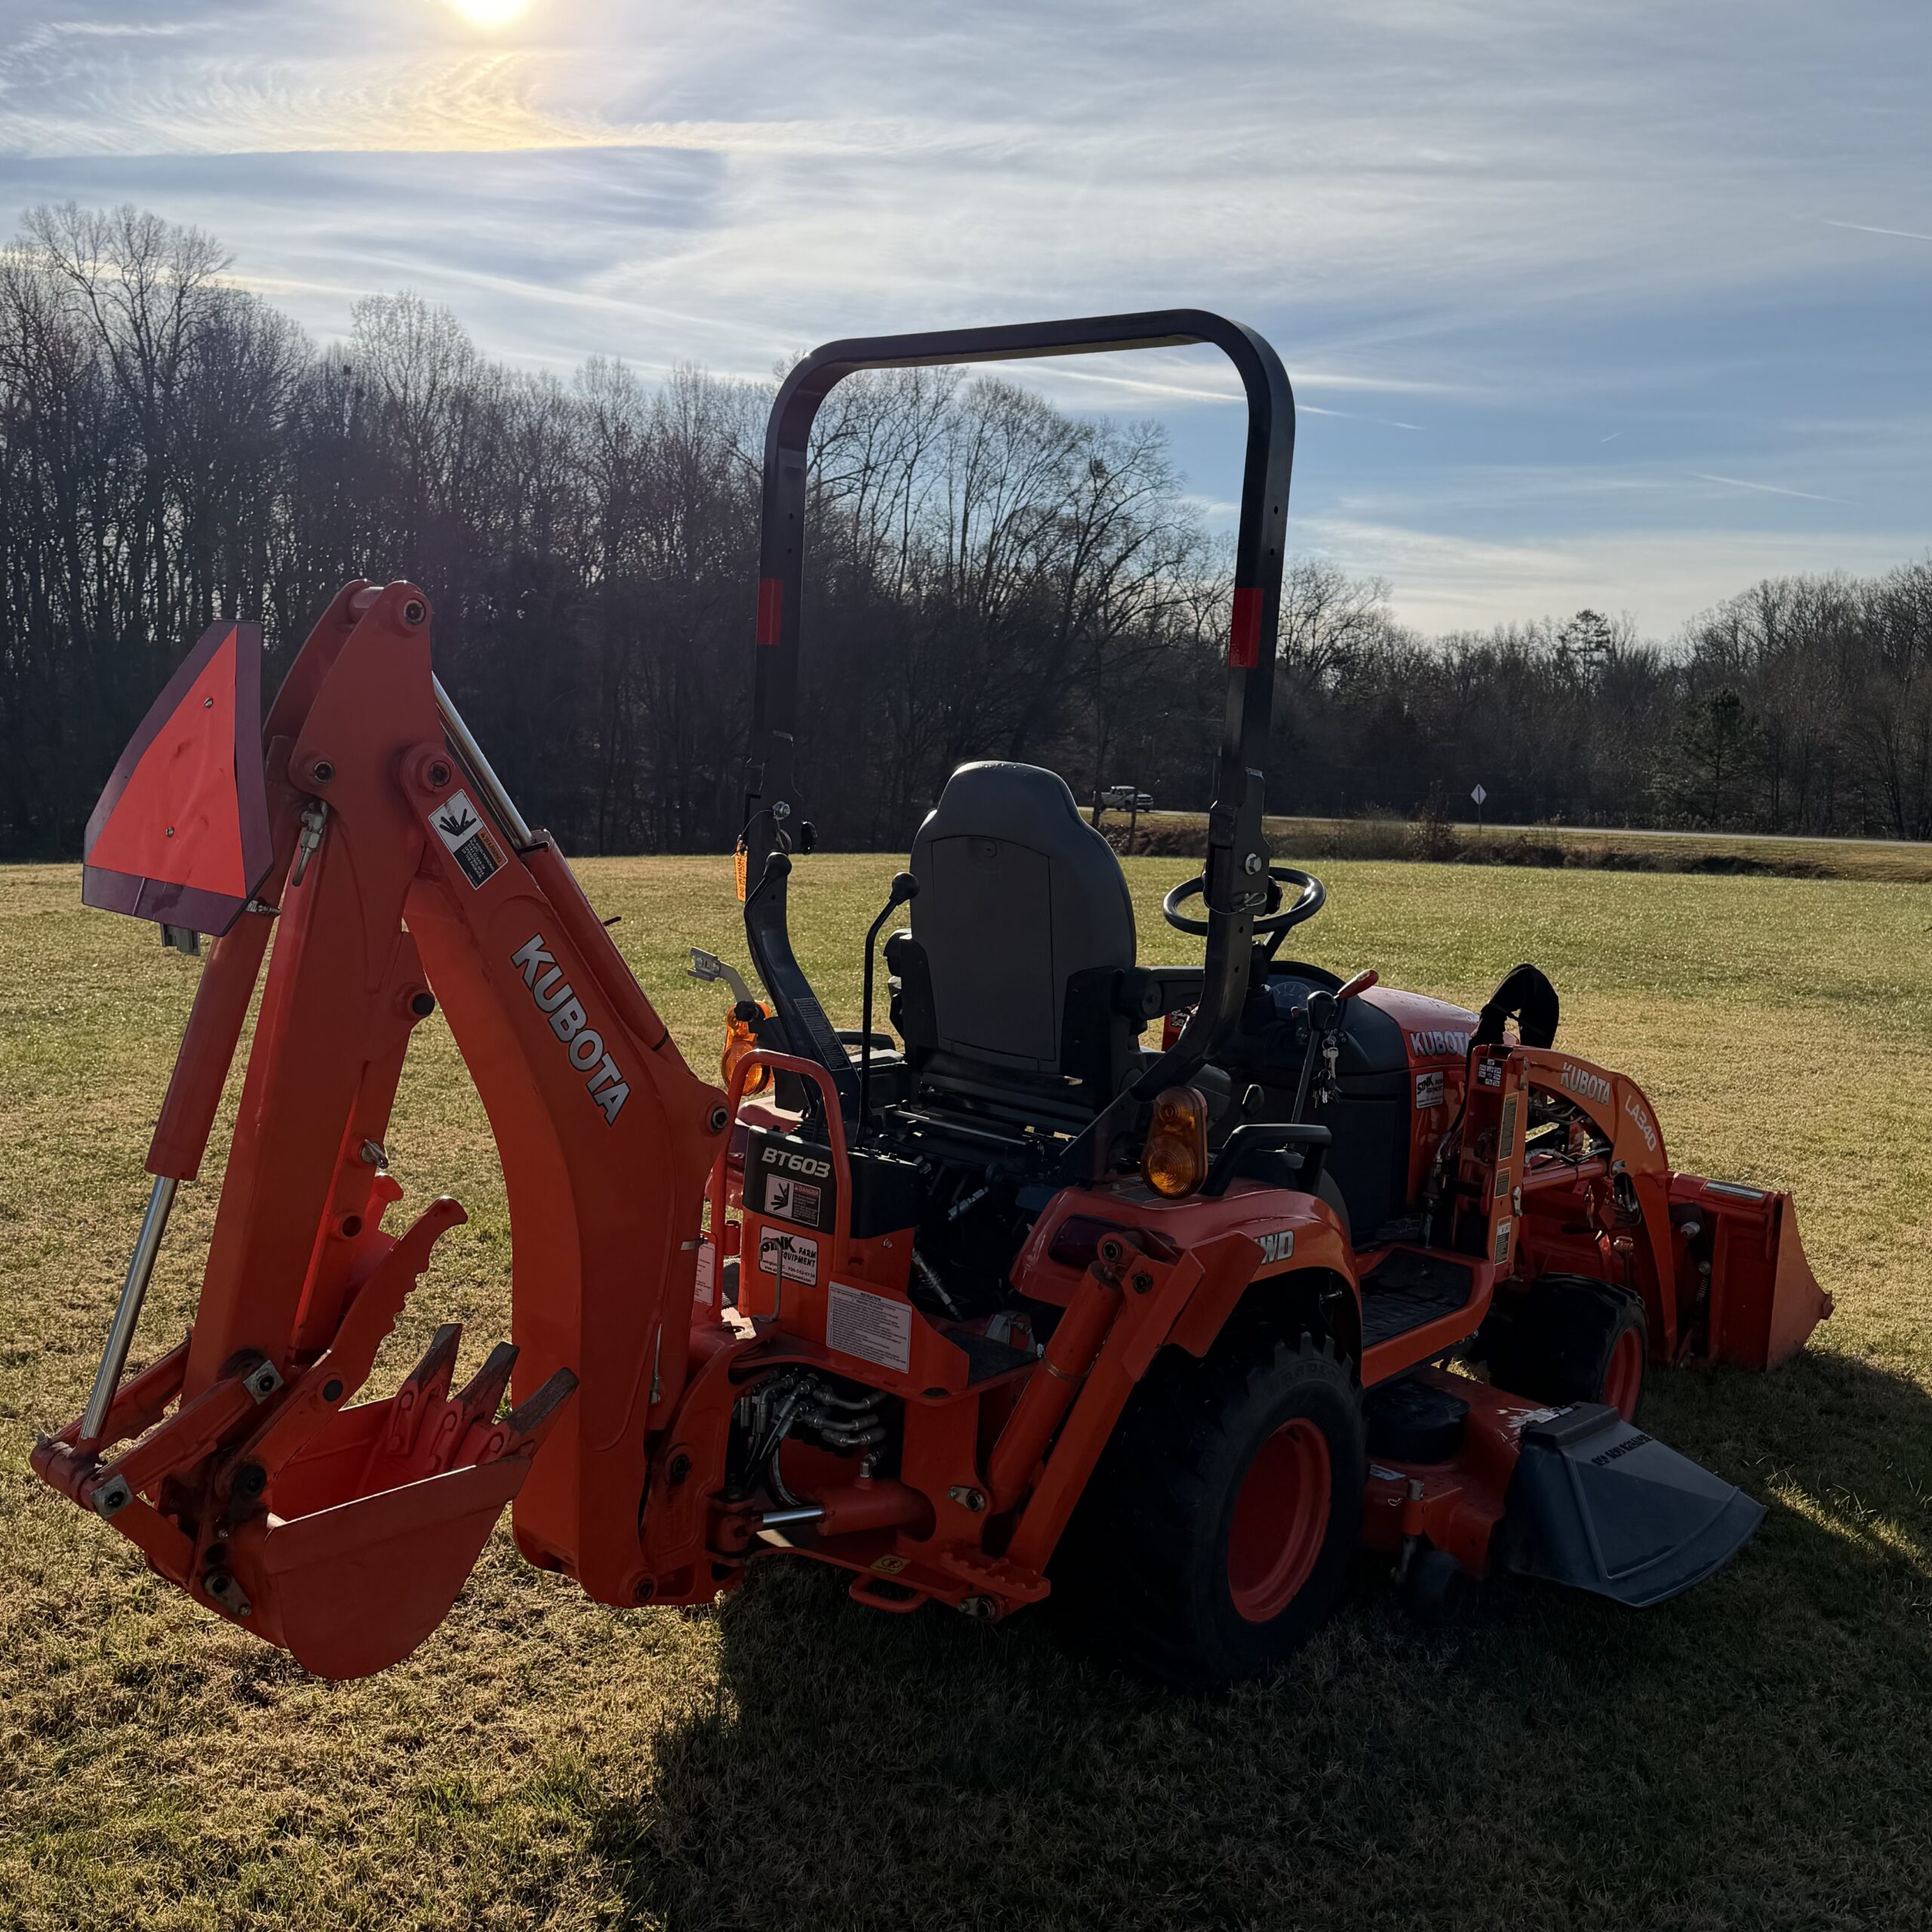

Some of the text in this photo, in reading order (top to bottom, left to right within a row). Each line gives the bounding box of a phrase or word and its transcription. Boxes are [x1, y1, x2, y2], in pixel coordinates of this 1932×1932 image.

[482, 835, 503, 863] WARNING
[510, 932, 631, 1128] KUBOTA
[1560, 1062, 1611, 1106] KUBOTA
[1625, 1094, 1657, 1152] LA340
[761, 1147, 830, 1178] BT603
[798, 1247, 817, 1258] FARM
[1254, 1229, 1294, 1265] WD
